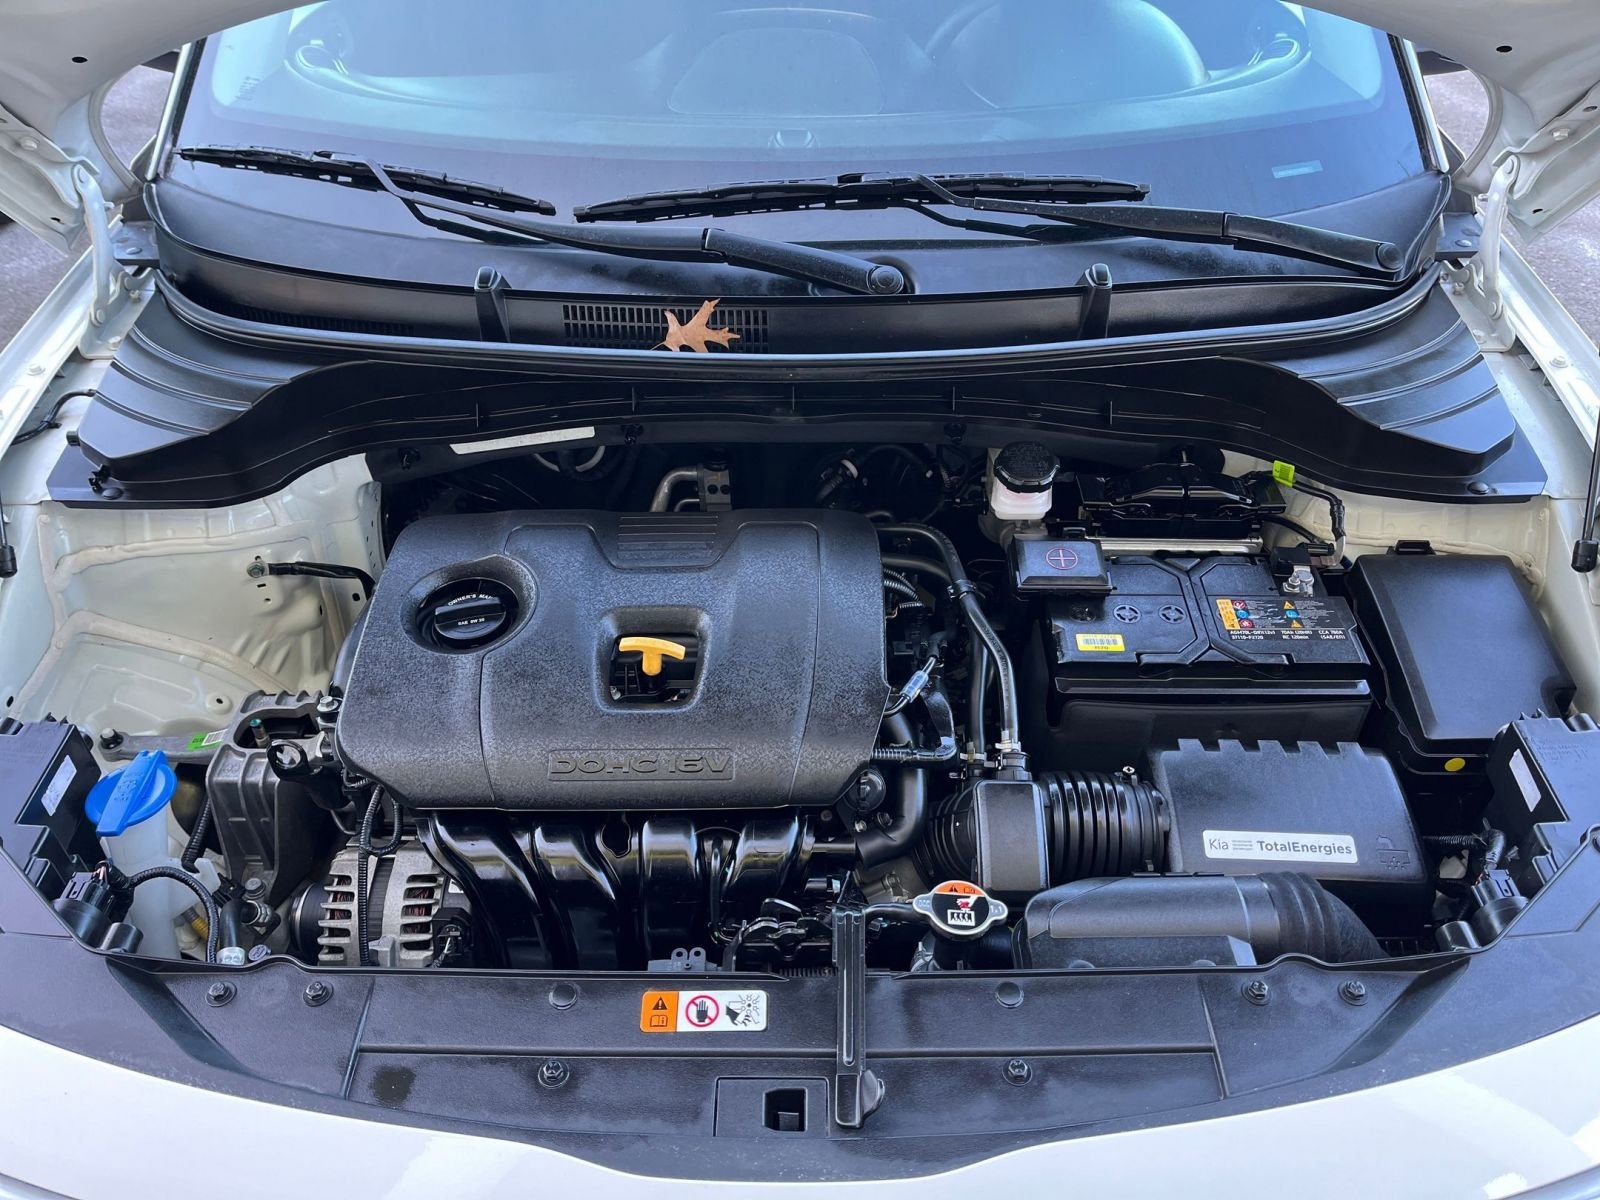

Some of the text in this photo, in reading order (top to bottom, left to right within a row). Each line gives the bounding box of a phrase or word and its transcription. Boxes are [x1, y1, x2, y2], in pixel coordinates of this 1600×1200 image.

[447, 593, 477, 606] OWNER'S
[550, 756, 731, 774] DOHC 16V
[1208, 838, 1353, 856] Kia TotalEnergies
